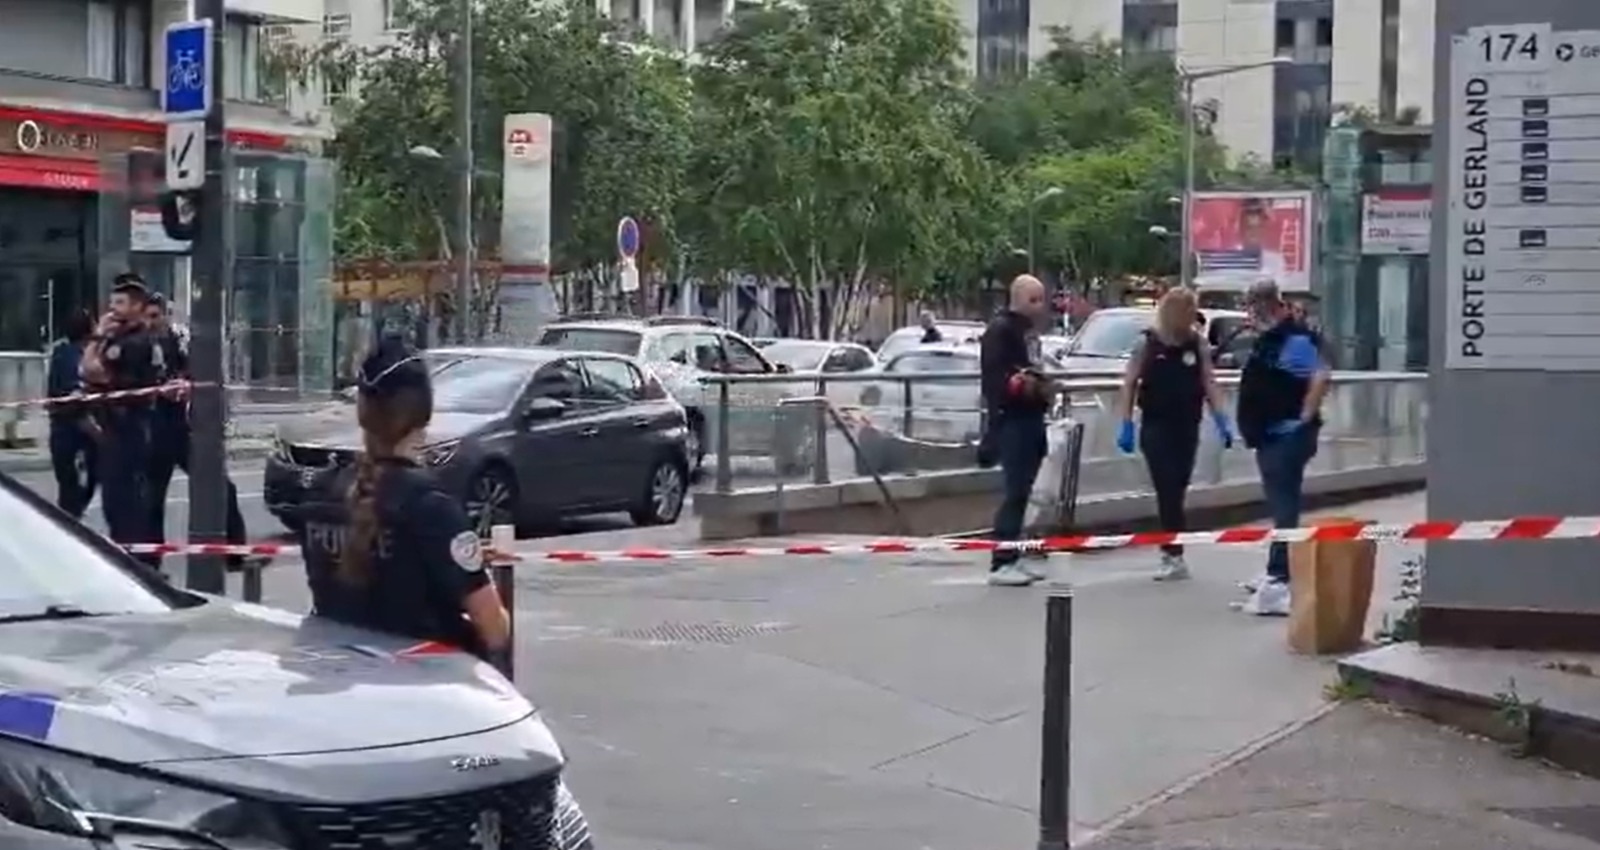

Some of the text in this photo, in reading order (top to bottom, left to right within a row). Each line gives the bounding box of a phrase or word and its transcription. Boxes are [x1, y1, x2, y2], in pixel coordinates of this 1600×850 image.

[1480, 33, 1537, 61] 174
[1462, 78, 1488, 357] PORTE DE GERLAND
[305, 522, 393, 559] POLE
